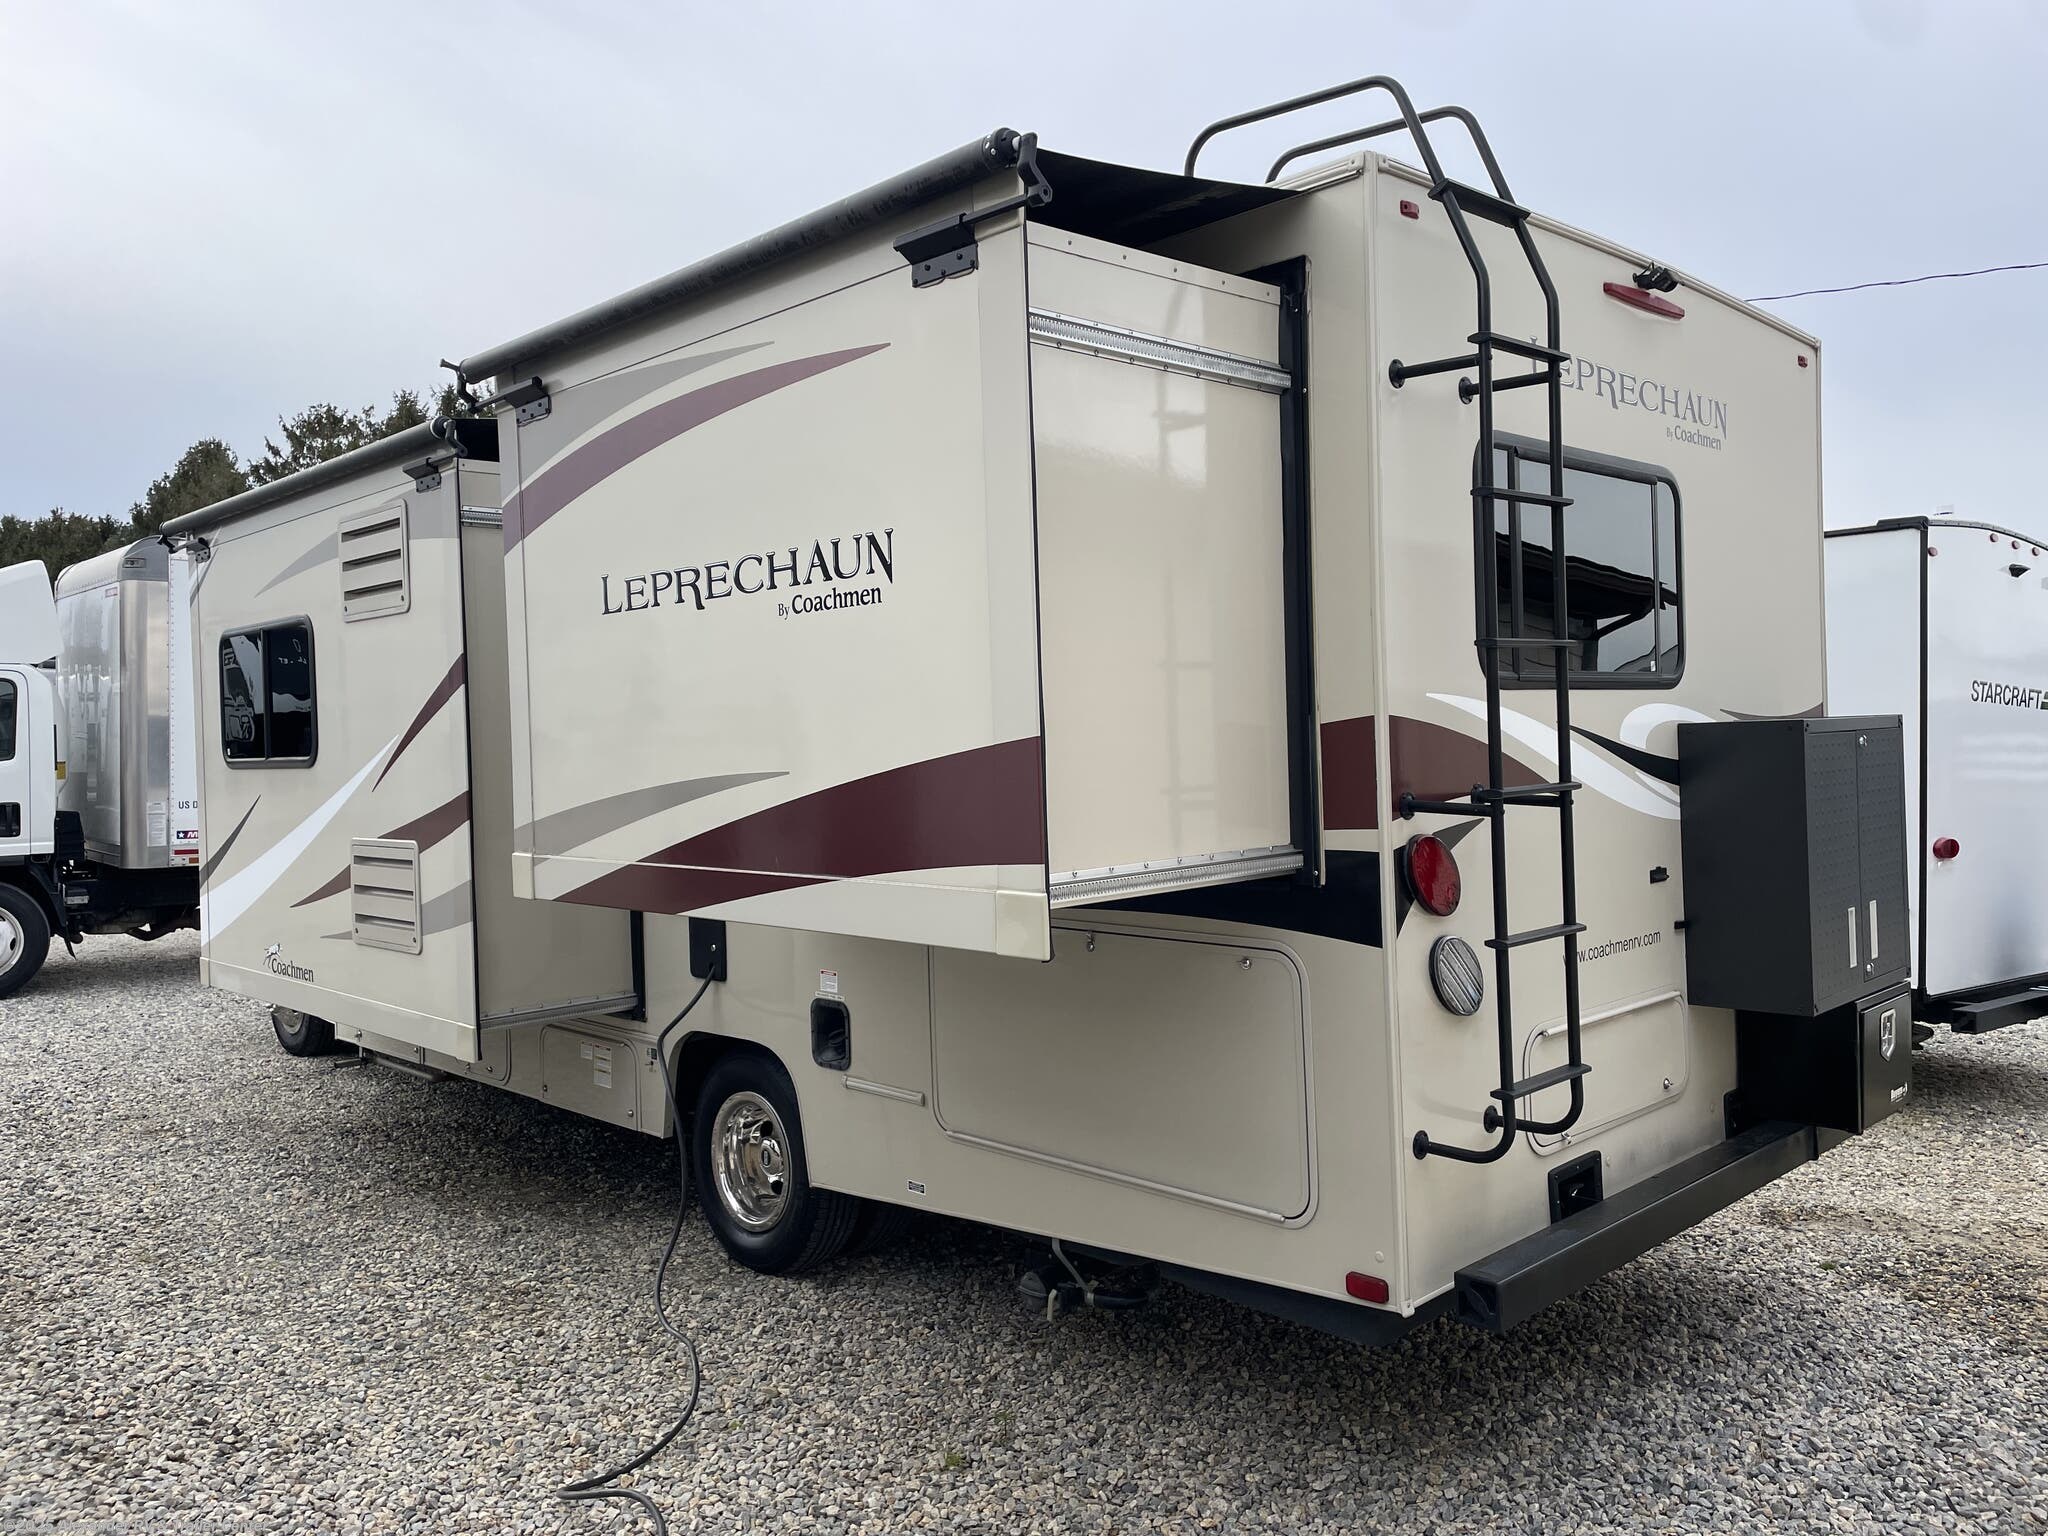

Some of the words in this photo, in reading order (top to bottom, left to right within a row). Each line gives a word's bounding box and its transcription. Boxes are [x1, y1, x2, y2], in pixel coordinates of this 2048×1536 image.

[1666, 426, 1674, 441] By
[1674, 425, 1722, 451] Coachmen
[601, 528, 893, 615] LEPRECHAUN
[778, 603, 790, 620] By
[792, 587, 882, 614] Coachmen
[1971, 680, 2042, 709] STARCRAFT
[178, 800, 190, 809] US
[271, 958, 314, 982] Coachmen
